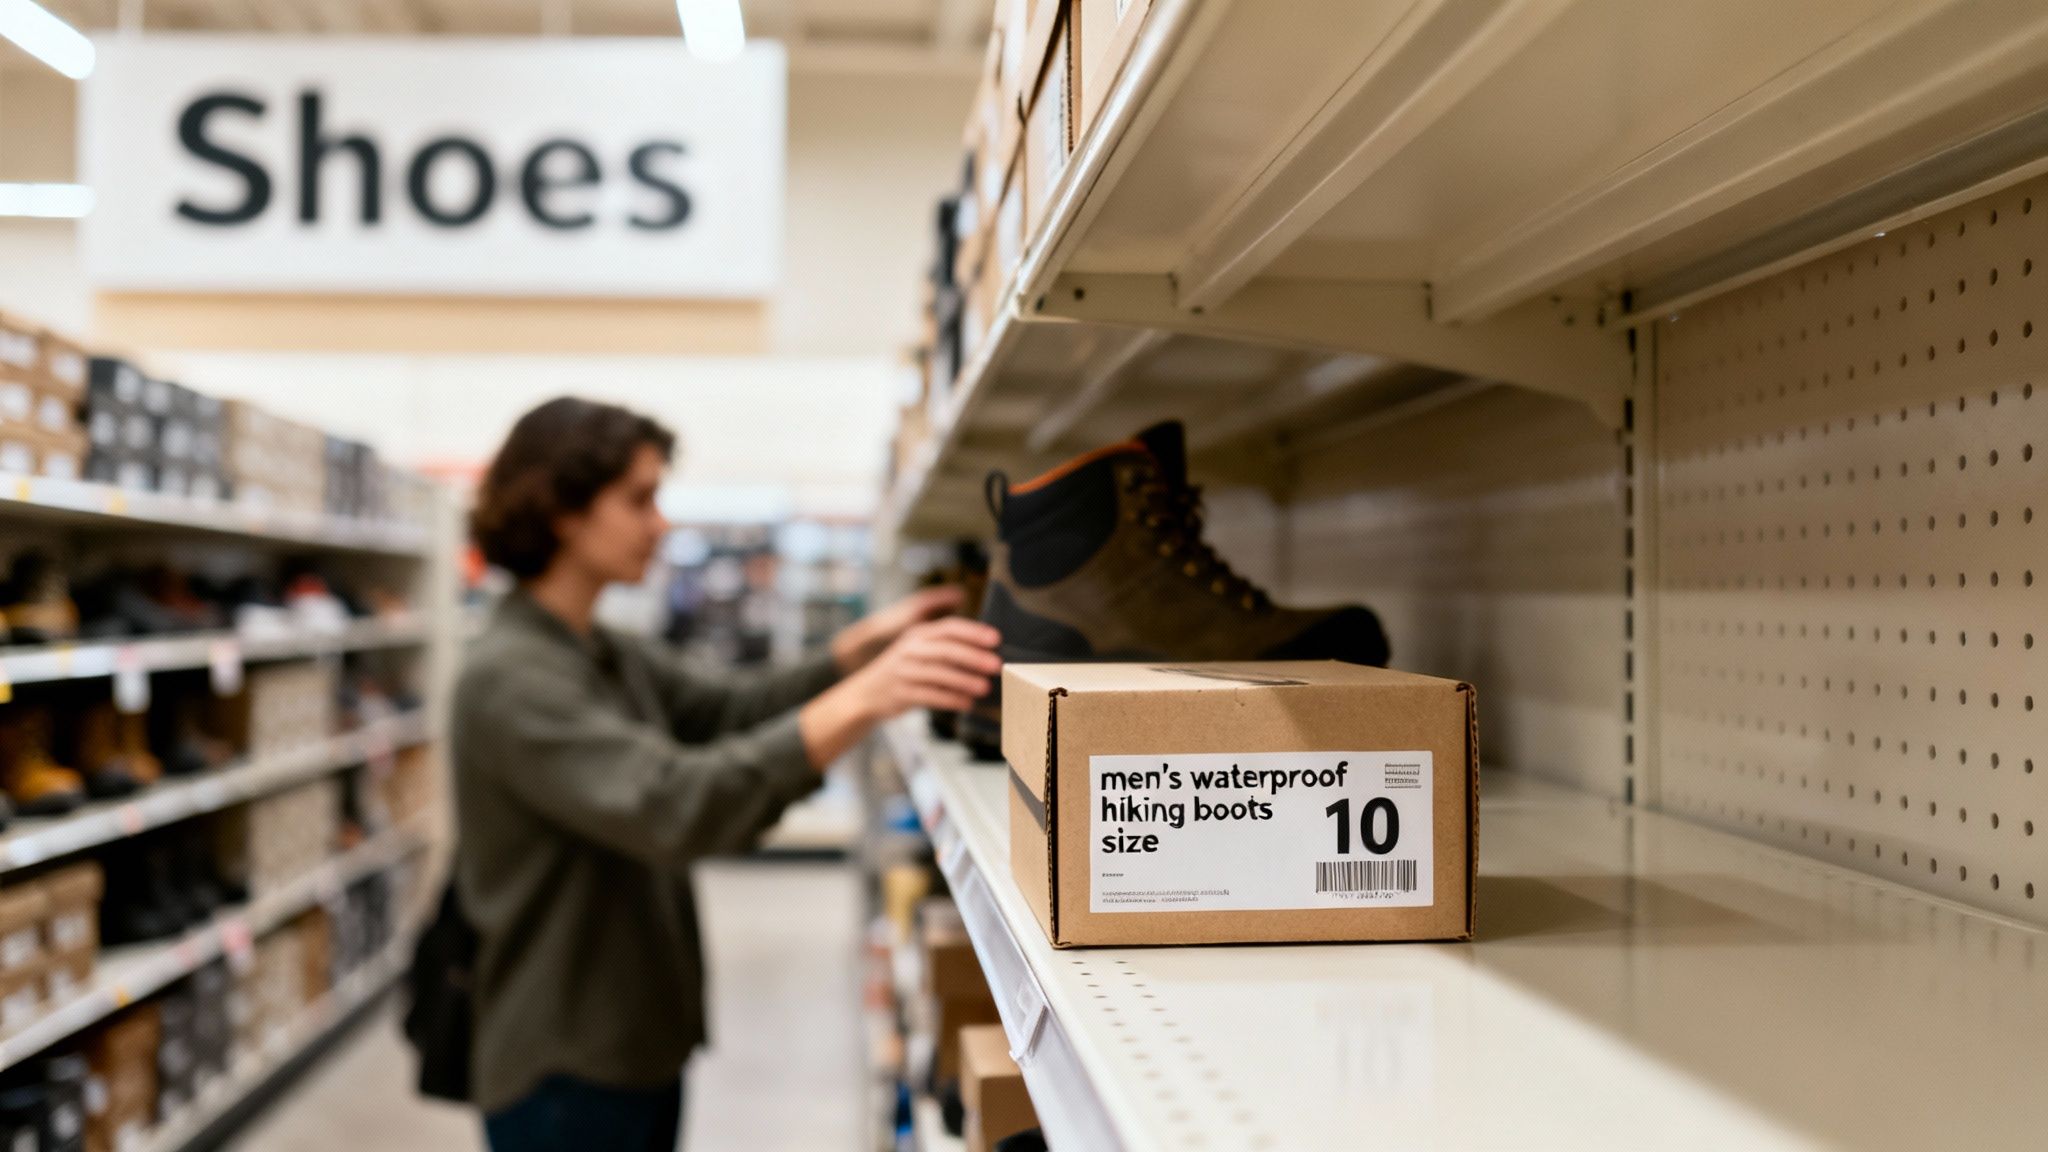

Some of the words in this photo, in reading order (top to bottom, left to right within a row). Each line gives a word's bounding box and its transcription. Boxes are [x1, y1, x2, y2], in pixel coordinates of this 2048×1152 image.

[175, 89, 692, 231] Shoes
[1101, 763, 1183, 791] men's
[1190, 761, 1349, 795] waterproof
[1101, 795, 1185, 829] hiking
[1193, 795, 1274, 822] boots
[1325, 797, 1400, 855] 10
[1101, 827, 1160, 853] size
